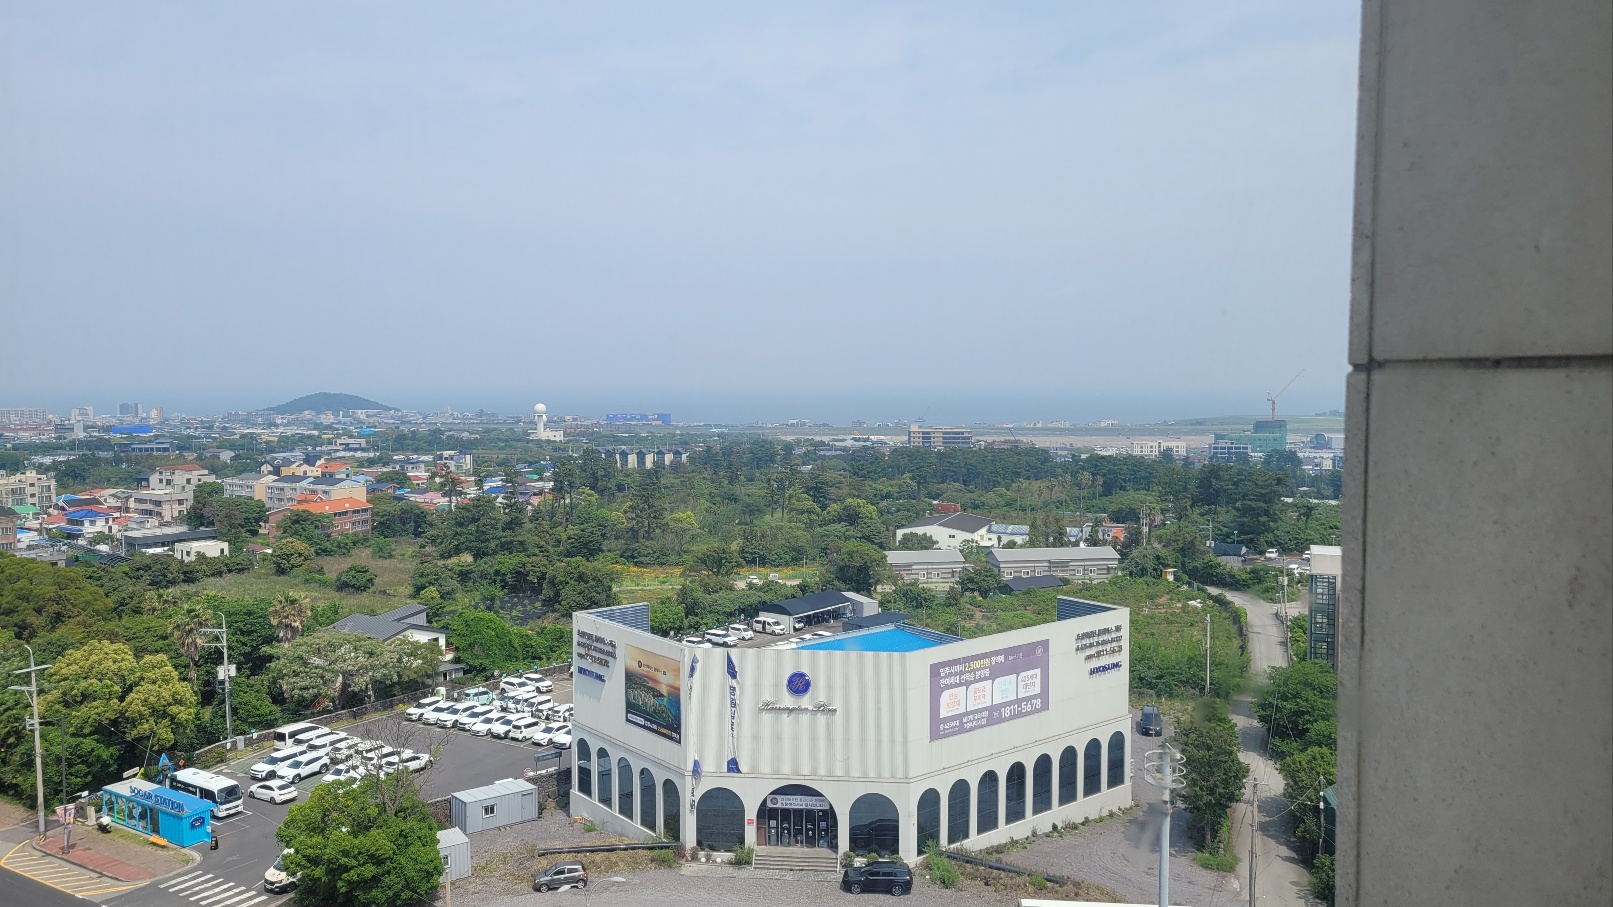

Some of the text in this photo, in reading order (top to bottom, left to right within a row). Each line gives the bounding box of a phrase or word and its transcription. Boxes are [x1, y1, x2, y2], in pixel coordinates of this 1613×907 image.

[1089, 661, 1122, 675] HYOSUNG
[1000, 698, 1041, 718] 1811-5678
[154, 793, 185, 812] STATION
